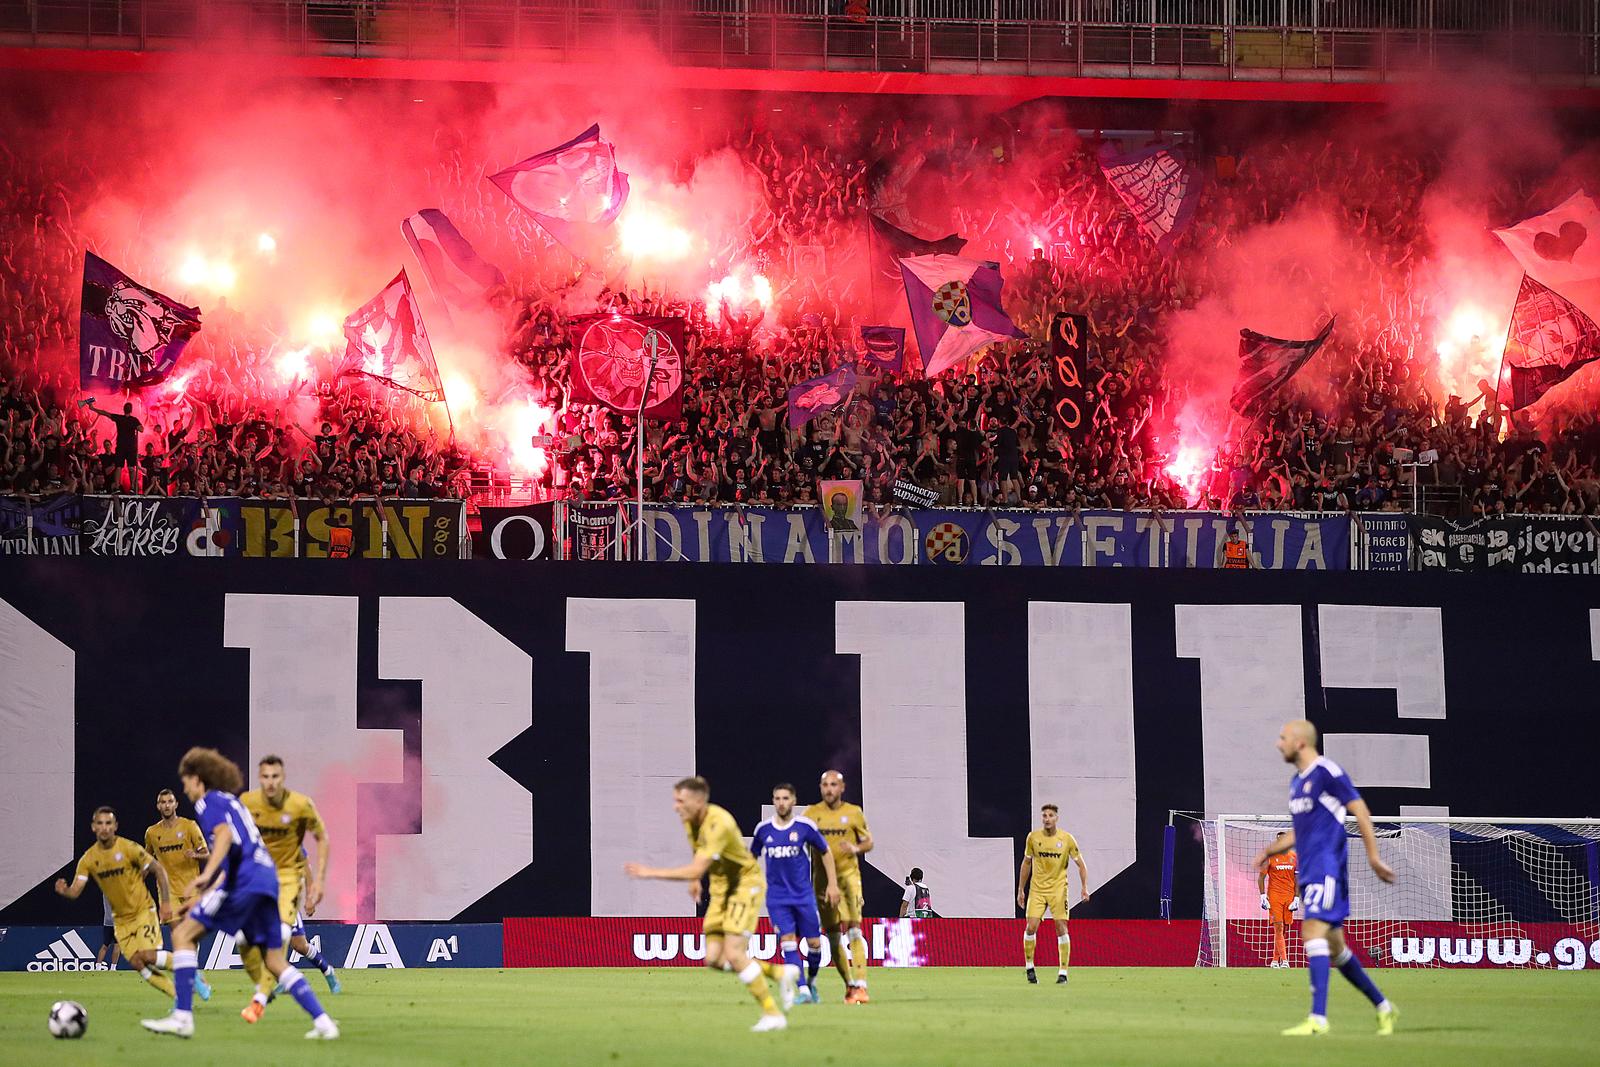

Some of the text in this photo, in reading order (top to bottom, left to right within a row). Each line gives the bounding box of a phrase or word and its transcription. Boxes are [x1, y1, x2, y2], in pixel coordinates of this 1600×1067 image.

[569, 509, 616, 526] dinamo
[1364, 520, 1407, 531] DINAMO
[641, 511, 914, 564] DINAMO
[1372, 536, 1406, 547] AGREB
[426, 935, 459, 962] A1
[27, 957, 109, 971] adidas
